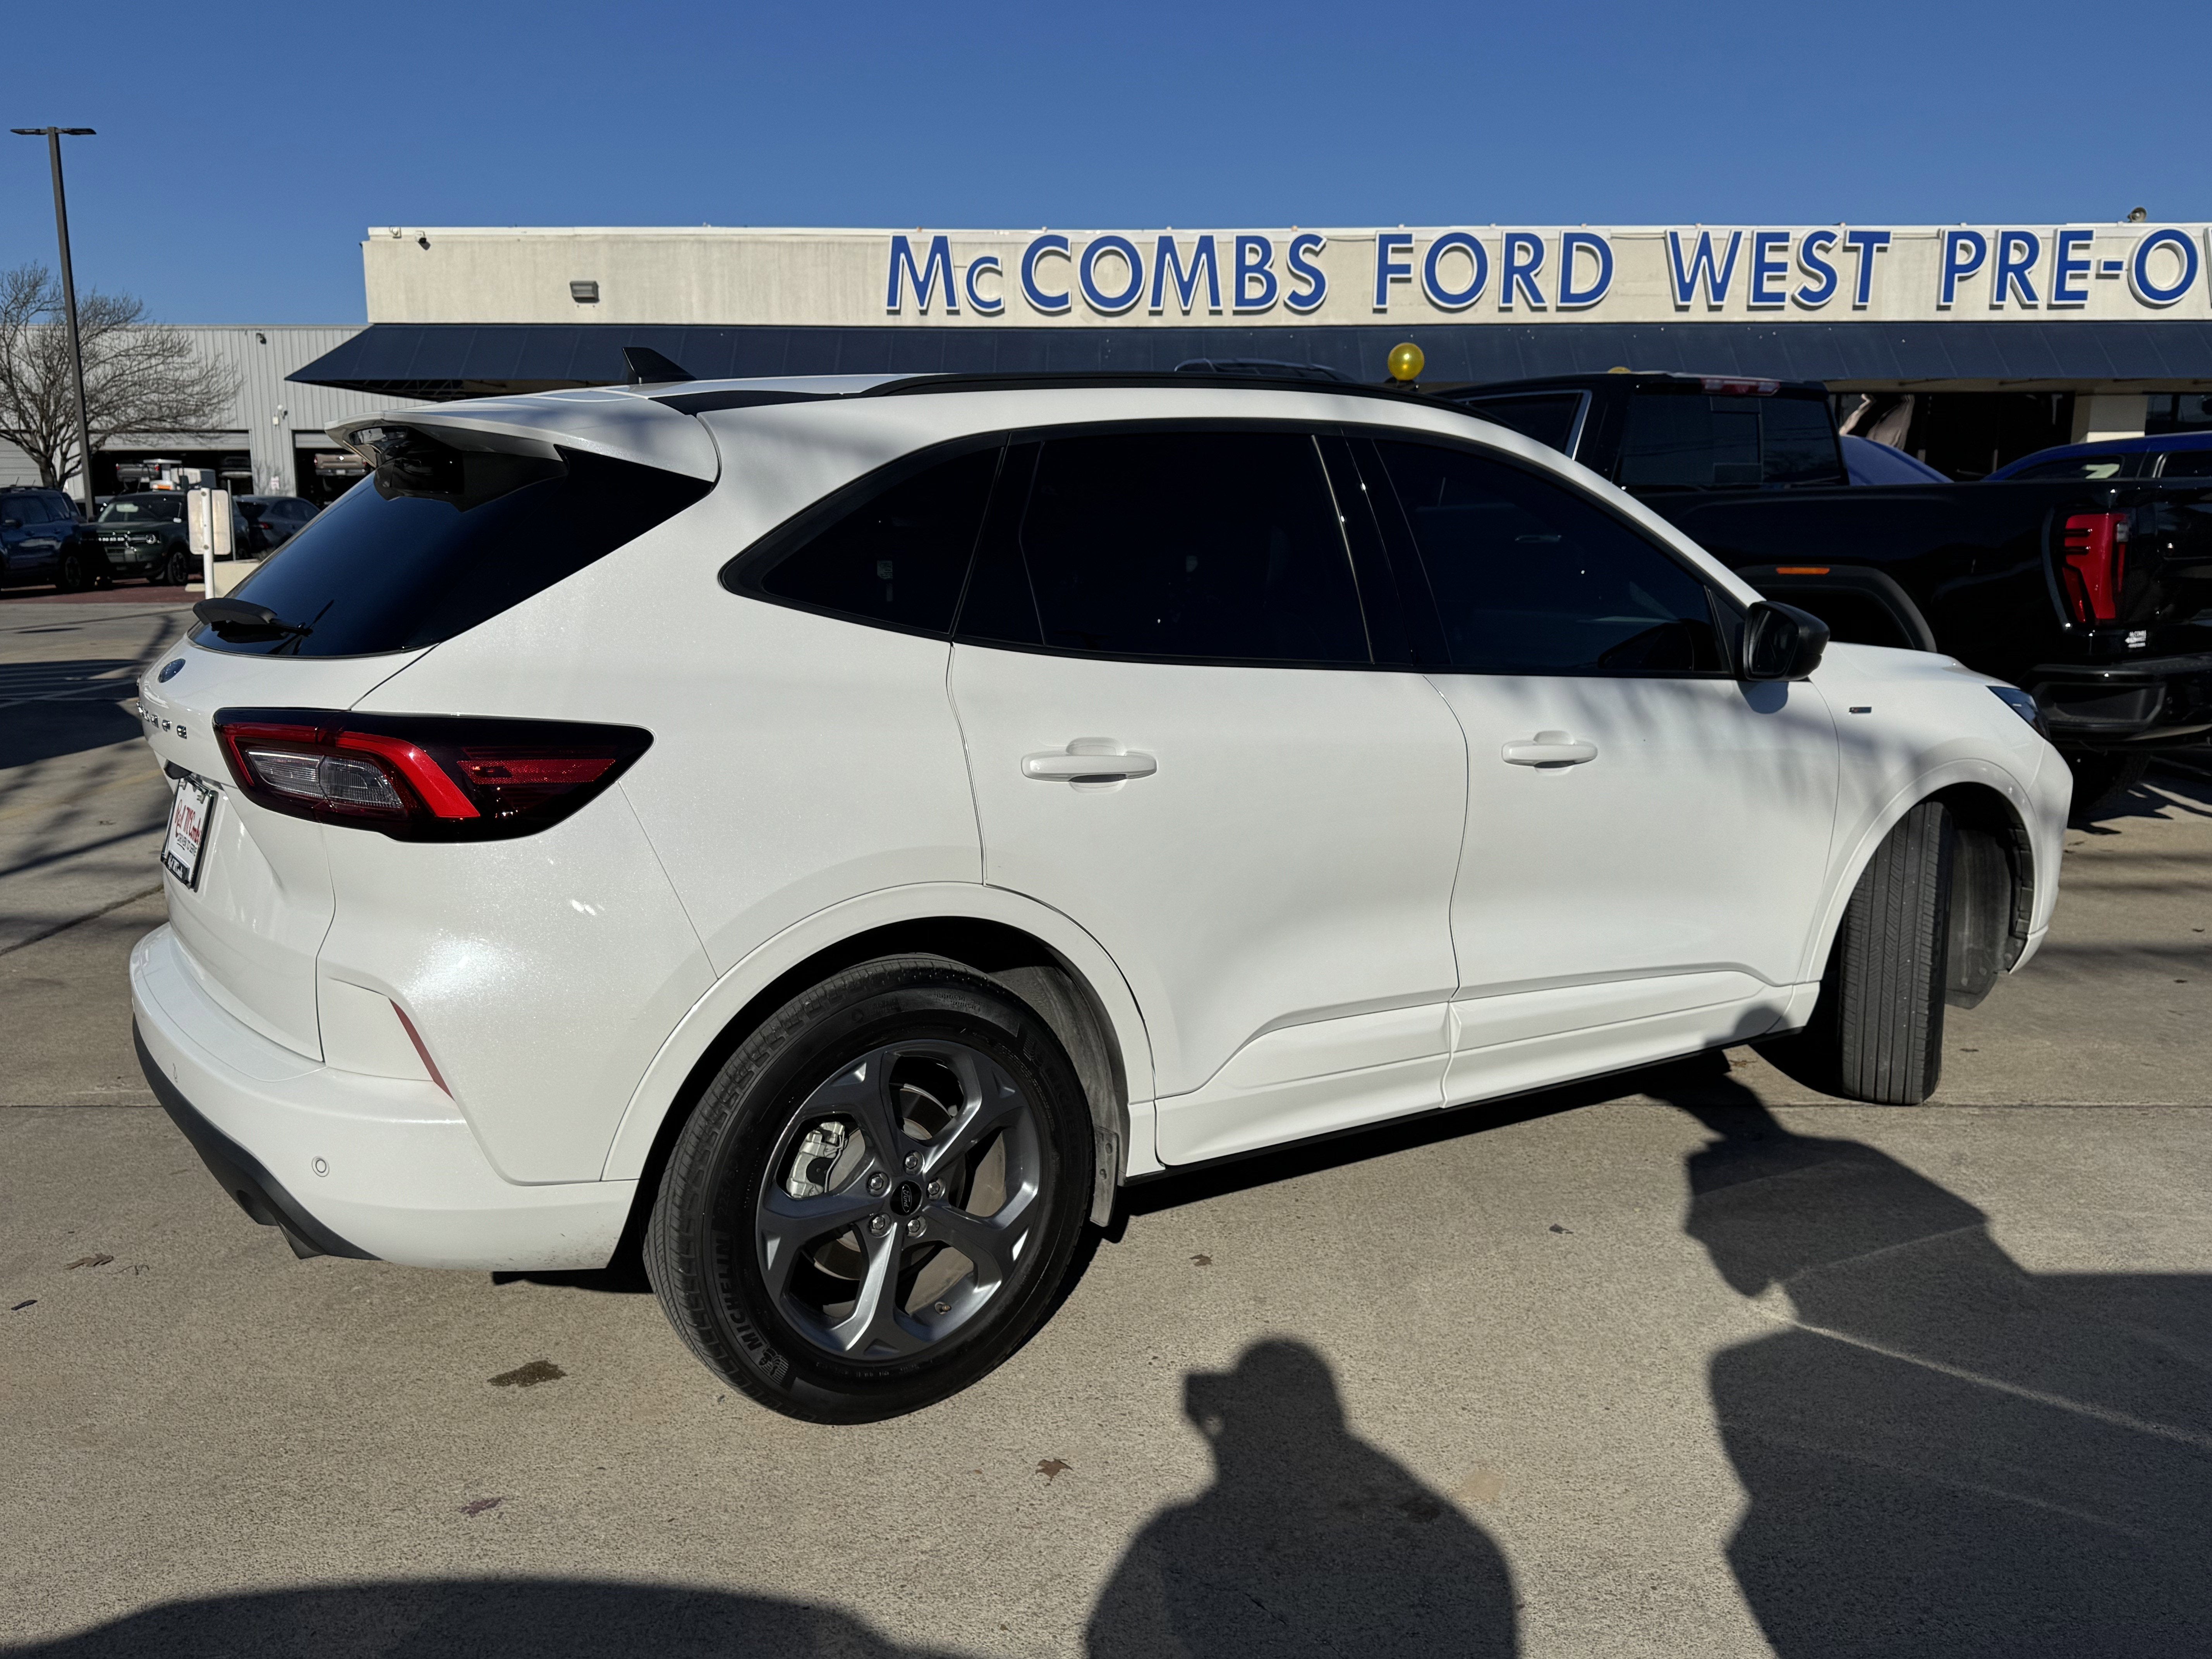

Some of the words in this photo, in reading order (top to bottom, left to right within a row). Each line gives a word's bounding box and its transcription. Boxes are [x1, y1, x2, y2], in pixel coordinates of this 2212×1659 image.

[886, 232, 1328, 311] McCOMBS
[1373, 229, 1614, 310] FORD
[1666, 228, 1893, 306] WEST
[1938, 226, 2212, 307] PRE-O
[716, 1237, 763, 1351] MICHELIN
